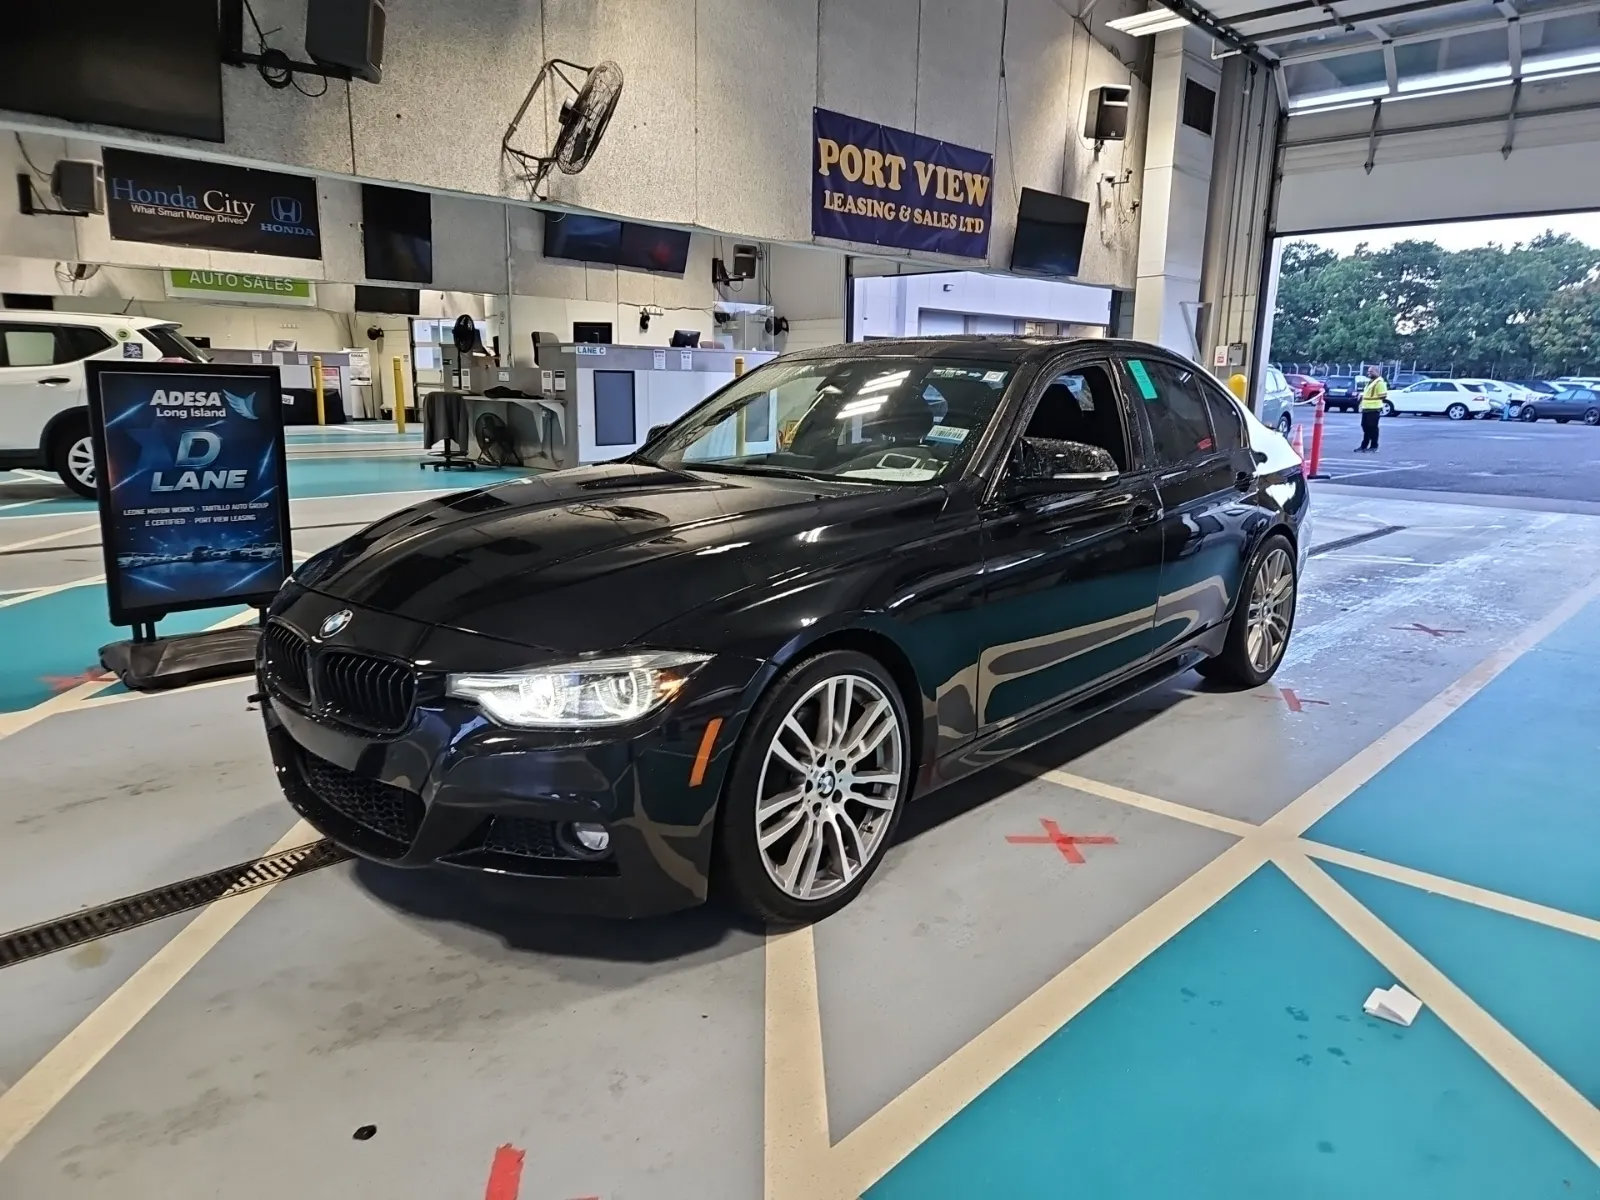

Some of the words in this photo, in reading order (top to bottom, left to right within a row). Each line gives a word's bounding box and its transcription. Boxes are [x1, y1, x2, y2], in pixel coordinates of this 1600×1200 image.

[817, 137, 907, 191] PORT
[913, 160, 990, 207] VIEW
[111, 177, 198, 210] Honda
[203, 190, 256, 222] City
[131, 204, 156, 215] What
[157, 206, 185, 219] Smart
[186, 210, 216, 224] Money
[217, 213, 245, 225] Drives
[823, 189, 896, 221] LEASING
[899, 204, 912, 222] &
[913, 208, 957, 230] SALES
[959, 215, 984, 234] LTD
[260, 223, 316, 237] HONDA
[189, 270, 238, 288] AUTO
[242, 275, 294, 292] SALES
[577, 346, 597, 354] LANE
[150, 389, 222, 407] ADESA
[156, 407, 188, 419] Long
[190, 407, 227, 418] Island
[175, 429, 222, 468] D
[151, 469, 248, 492] LANE
[151, 518, 186, 526] CERTIFIED
